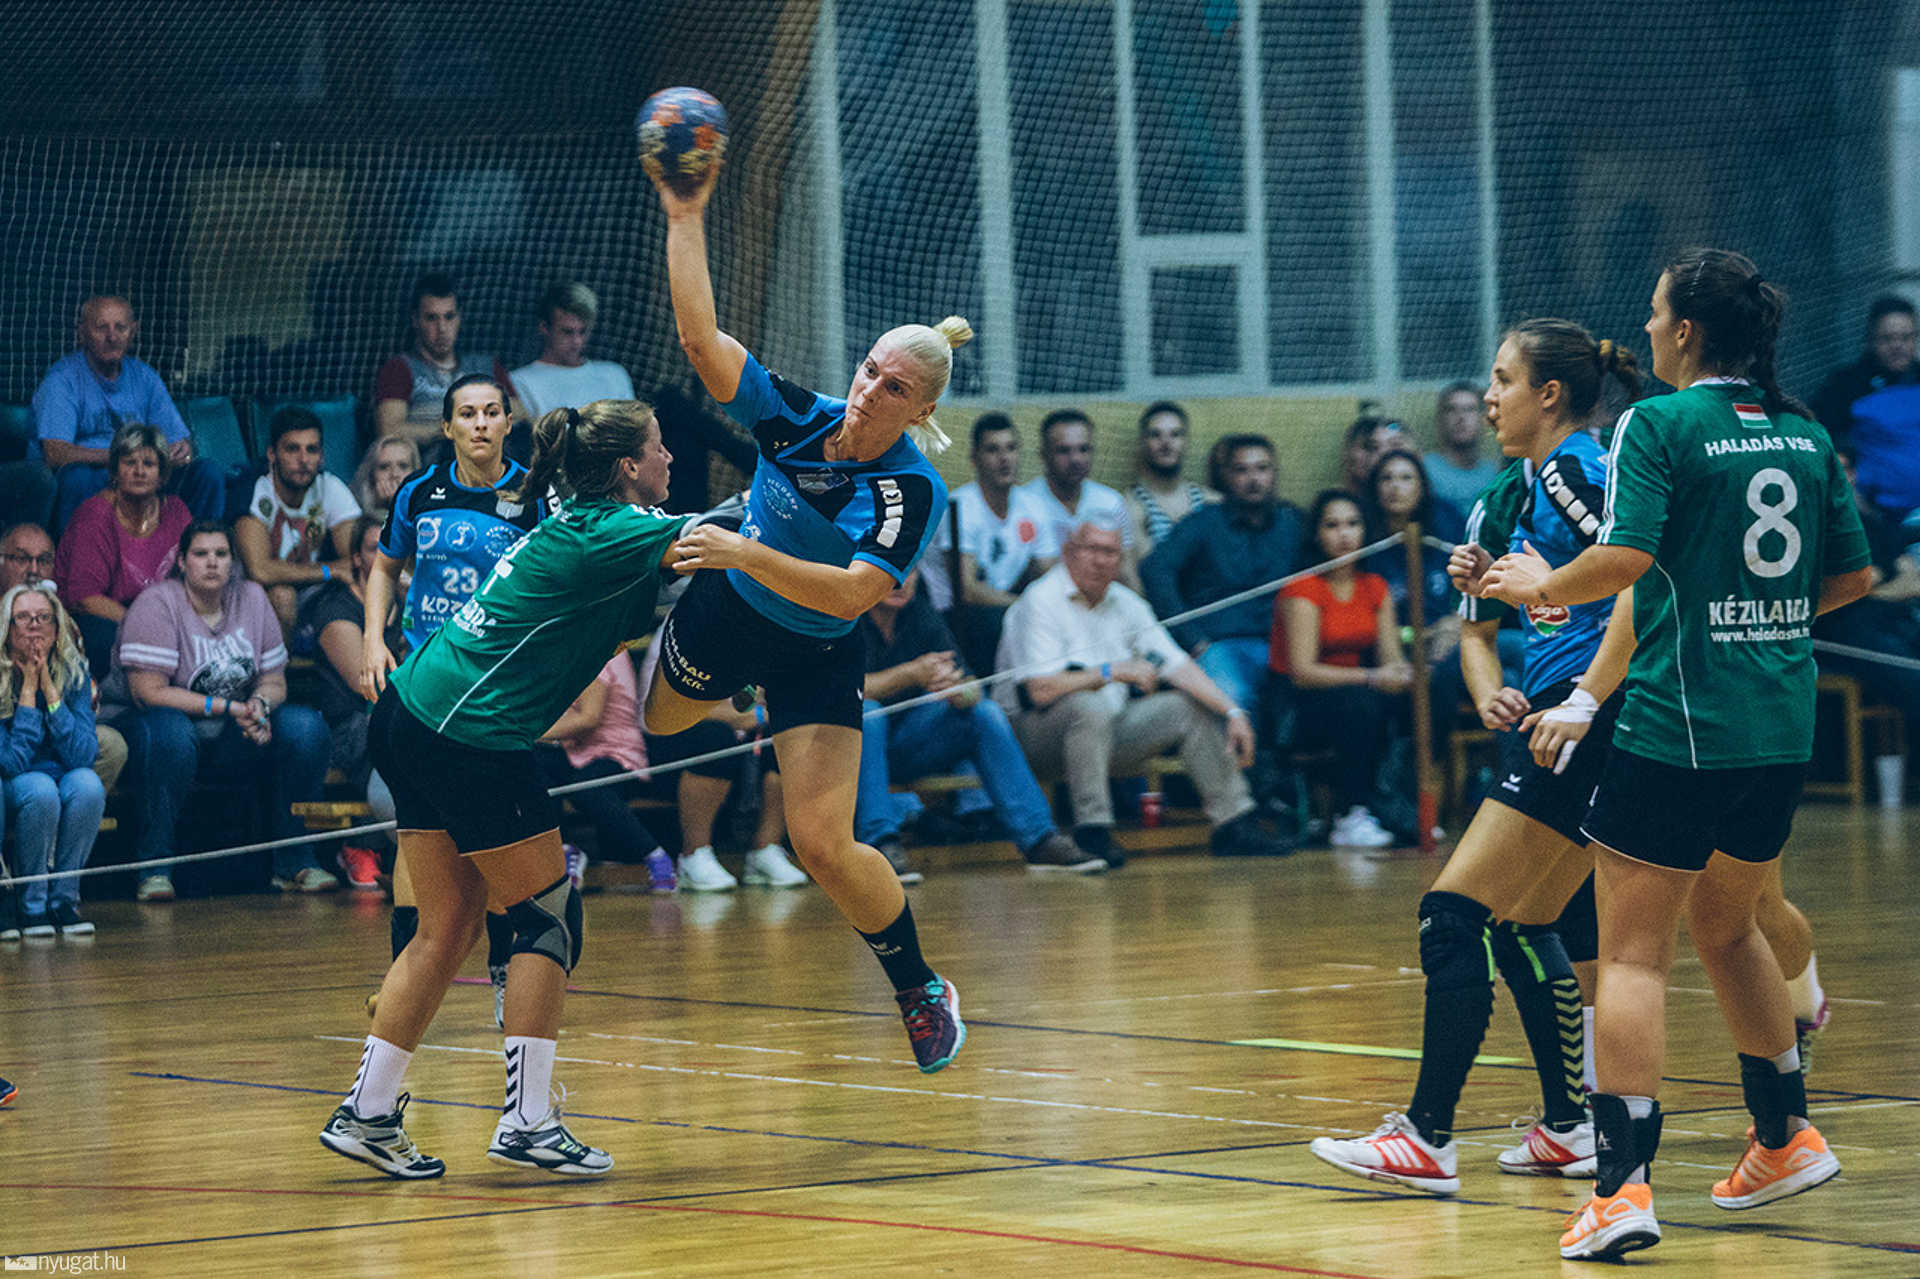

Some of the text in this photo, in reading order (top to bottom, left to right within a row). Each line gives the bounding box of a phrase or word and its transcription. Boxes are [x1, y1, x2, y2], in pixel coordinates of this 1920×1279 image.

[1704, 434, 1818, 457] HALADÁS VSE
[1743, 467, 1802, 578] 8
[442, 566, 479, 595] 23
